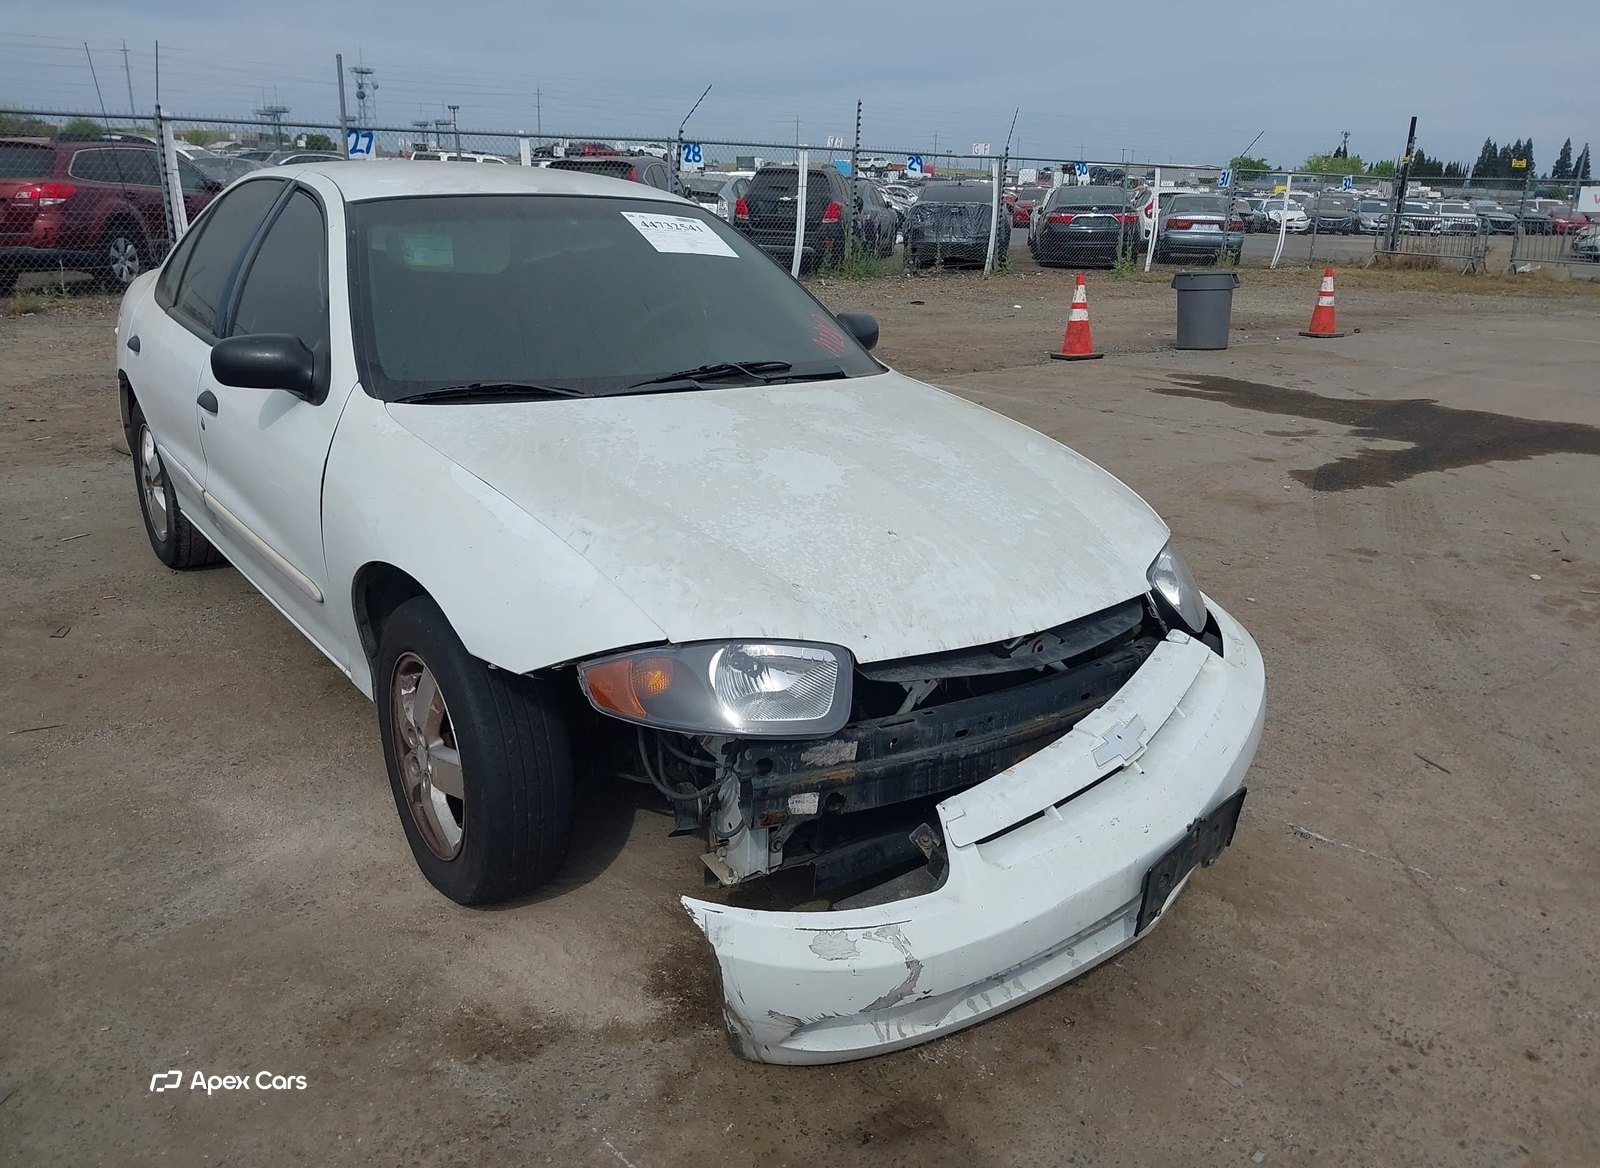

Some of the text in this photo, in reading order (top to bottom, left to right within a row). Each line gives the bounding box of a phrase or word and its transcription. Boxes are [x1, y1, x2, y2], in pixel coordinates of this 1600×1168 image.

[347, 129, 374, 155] 27
[973, 143, 980, 155] G
[682, 142, 702, 163] 28
[907, 154, 924, 174] 29
[1076, 163, 1088, 177] 30
[1219, 172, 1230, 186] 31
[1343, 177, 1352, 191] 32
[641, 220, 704, 233] 44732541
